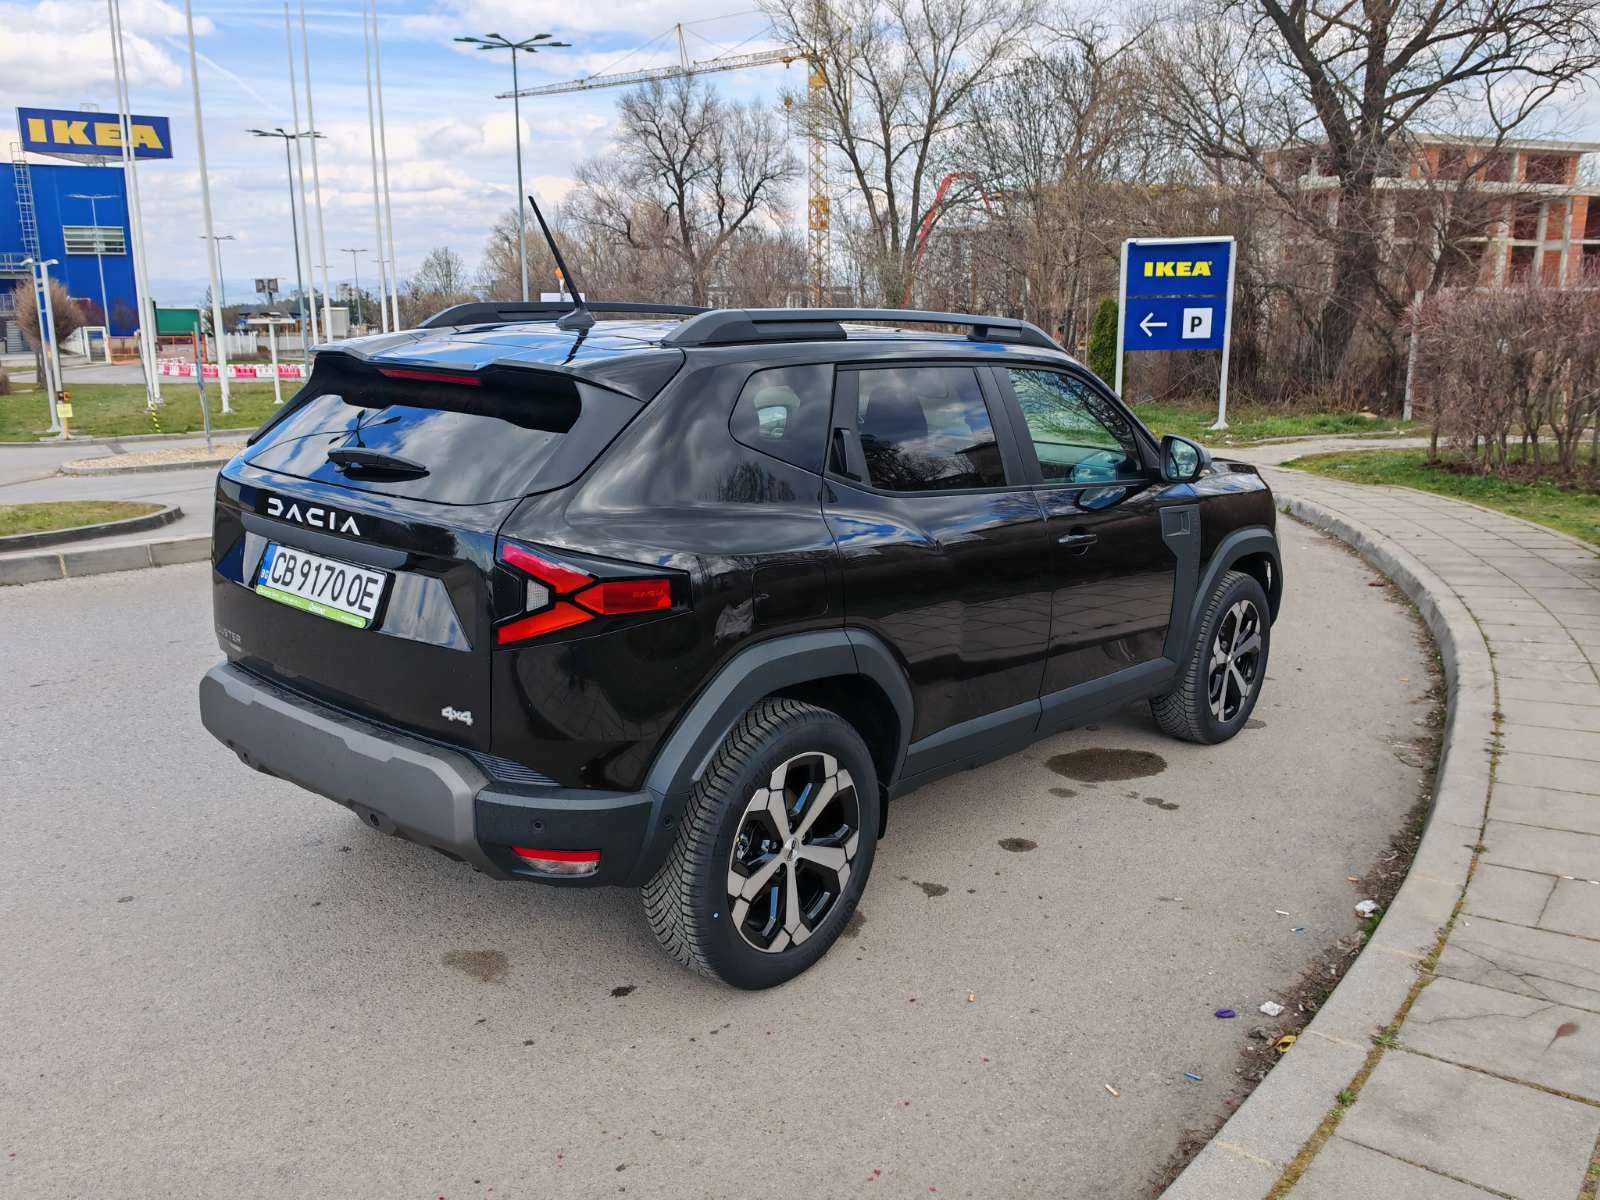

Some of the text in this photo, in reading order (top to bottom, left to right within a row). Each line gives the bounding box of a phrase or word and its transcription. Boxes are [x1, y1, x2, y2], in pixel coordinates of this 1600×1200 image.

[27, 118, 164, 149] IKEA
[1144, 261, 1212, 277] IKEA
[1190, 316, 1203, 332] P
[267, 498, 360, 536] DACIA
[271, 552, 297, 587] CB
[297, 559, 346, 606] 9170
[349, 573, 379, 613] OE
[441, 706, 473, 726] 4x4
